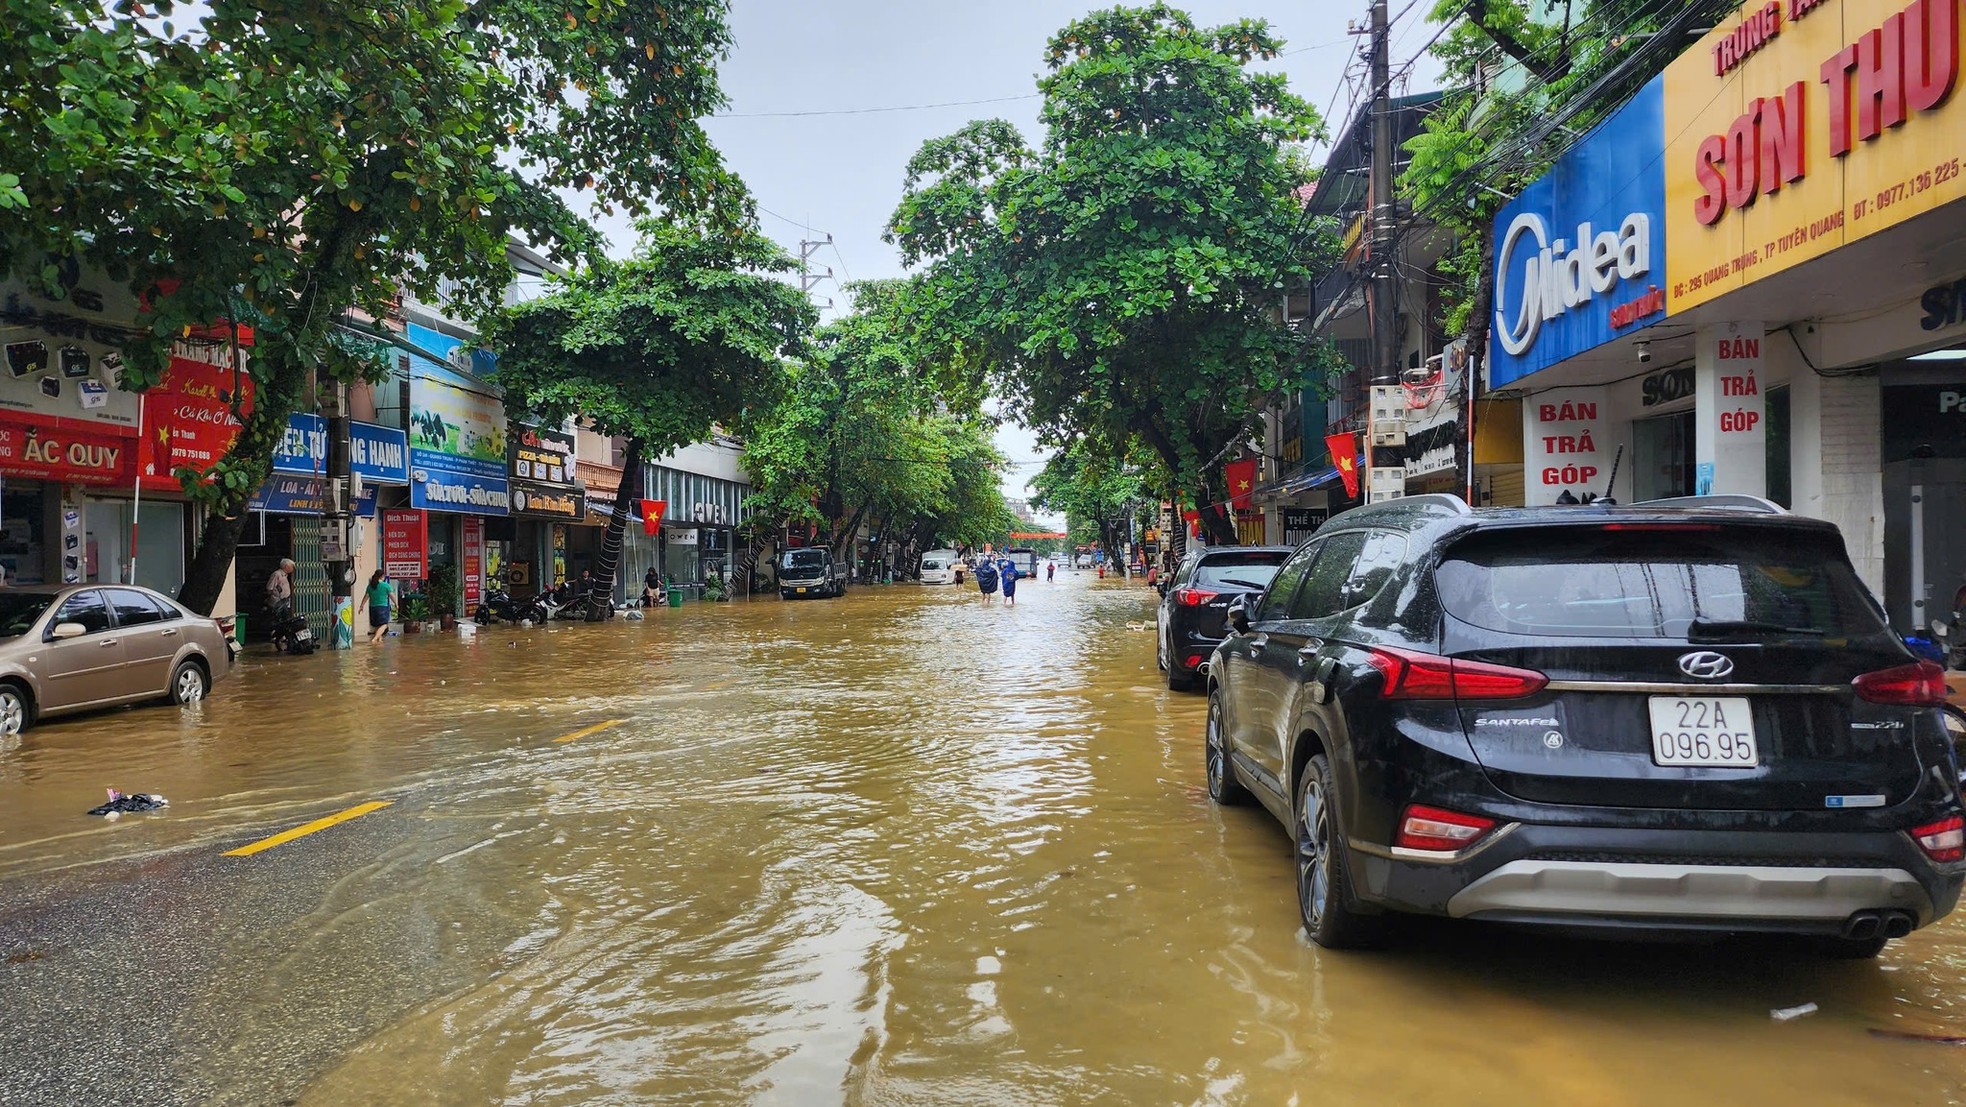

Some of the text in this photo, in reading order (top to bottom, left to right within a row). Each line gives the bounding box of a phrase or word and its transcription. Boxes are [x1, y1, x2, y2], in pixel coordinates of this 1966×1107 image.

[1711, 1, 1780, 77] TRUNG
[1695, 81, 1805, 226] SƠN
[1689, 274, 1702, 292] 295
[1703, 262, 1729, 287] QUANG
[1731, 249, 1758, 274] TRUNG
[1764, 242, 1776, 260] TP
[1778, 226, 1808, 254] TUYÊN
[1810, 209, 1845, 240] QUANG
[1934, 157, 1960, 186] 225
[1496, 213, 1650, 355] Midea
[1719, 335, 1759, 359] BÁN
[1721, 370, 1758, 396] TRẢ
[1539, 400, 1597, 422] BÁN
[1720, 408, 1759, 432] GÓP
[24, 428, 119, 469] ẮC QUY
[1542, 429, 1596, 454] TRẢ
[369, 439, 403, 472] HẠNH
[1542, 463, 1598, 485] GÓP
[280, 481, 297, 494] LOA
[694, 502, 727, 526] OWEN
[1287, 511, 1310, 525] THỂ
[1675, 700, 1728, 729] 22A
[1659, 732, 1751, 761] 096.95
